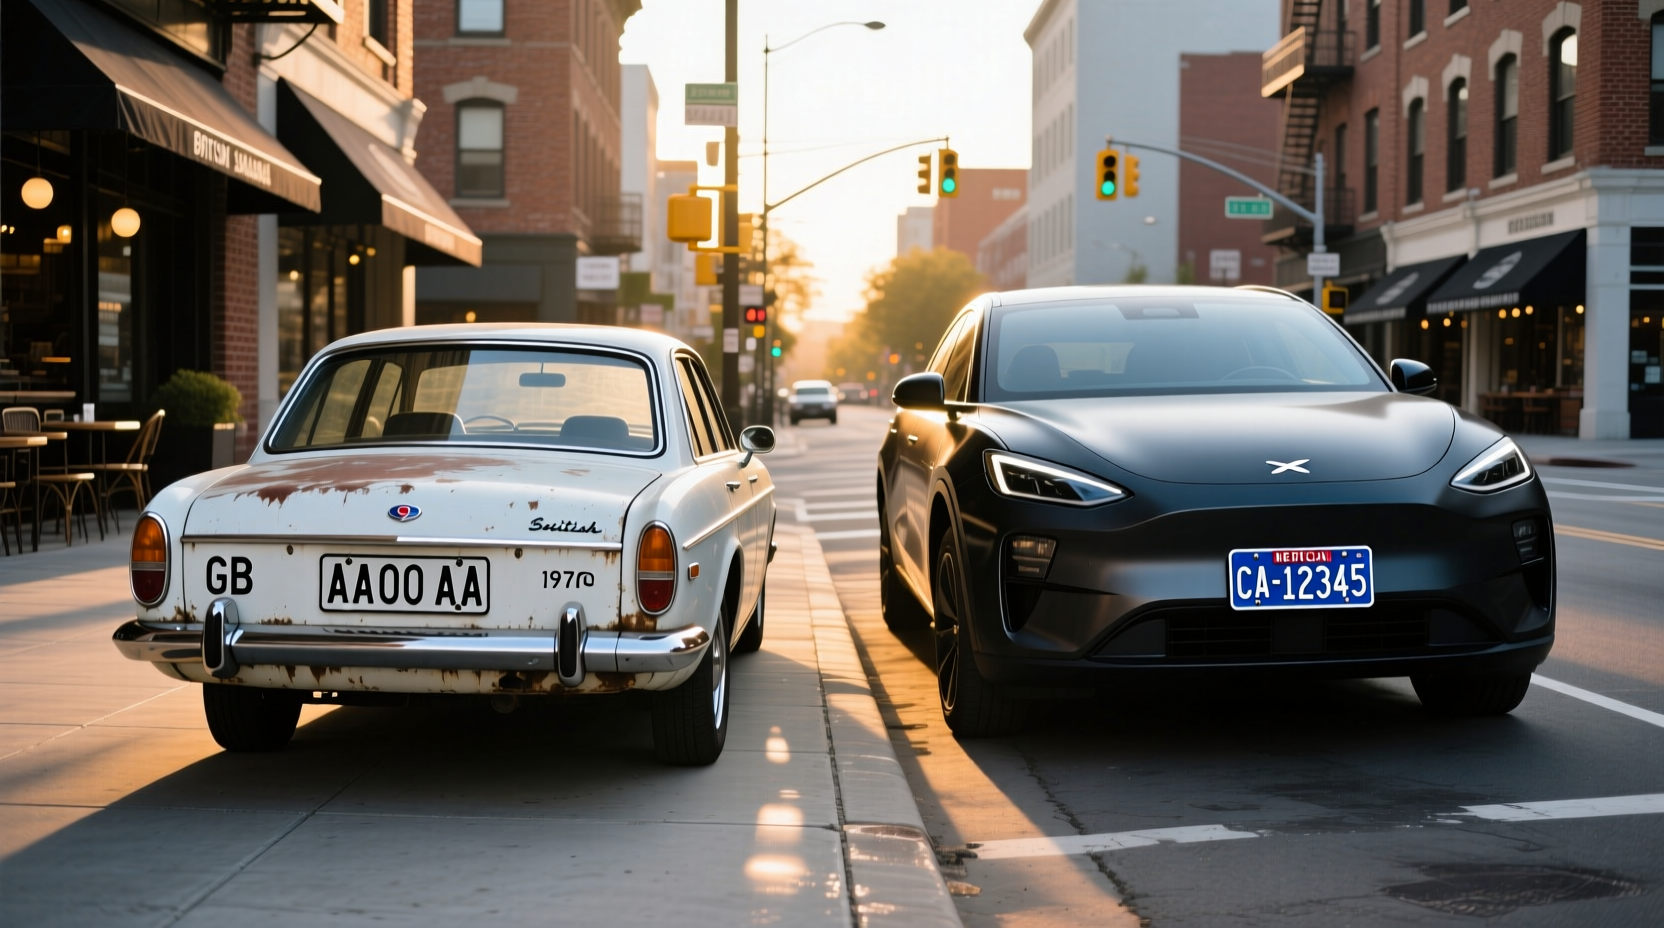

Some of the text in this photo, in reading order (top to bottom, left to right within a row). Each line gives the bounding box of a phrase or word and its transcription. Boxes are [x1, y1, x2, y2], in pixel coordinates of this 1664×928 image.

[206, 555, 254, 595] GB
[435, 565, 482, 607] AA
[1236, 563, 1367, 600] CA-12345
